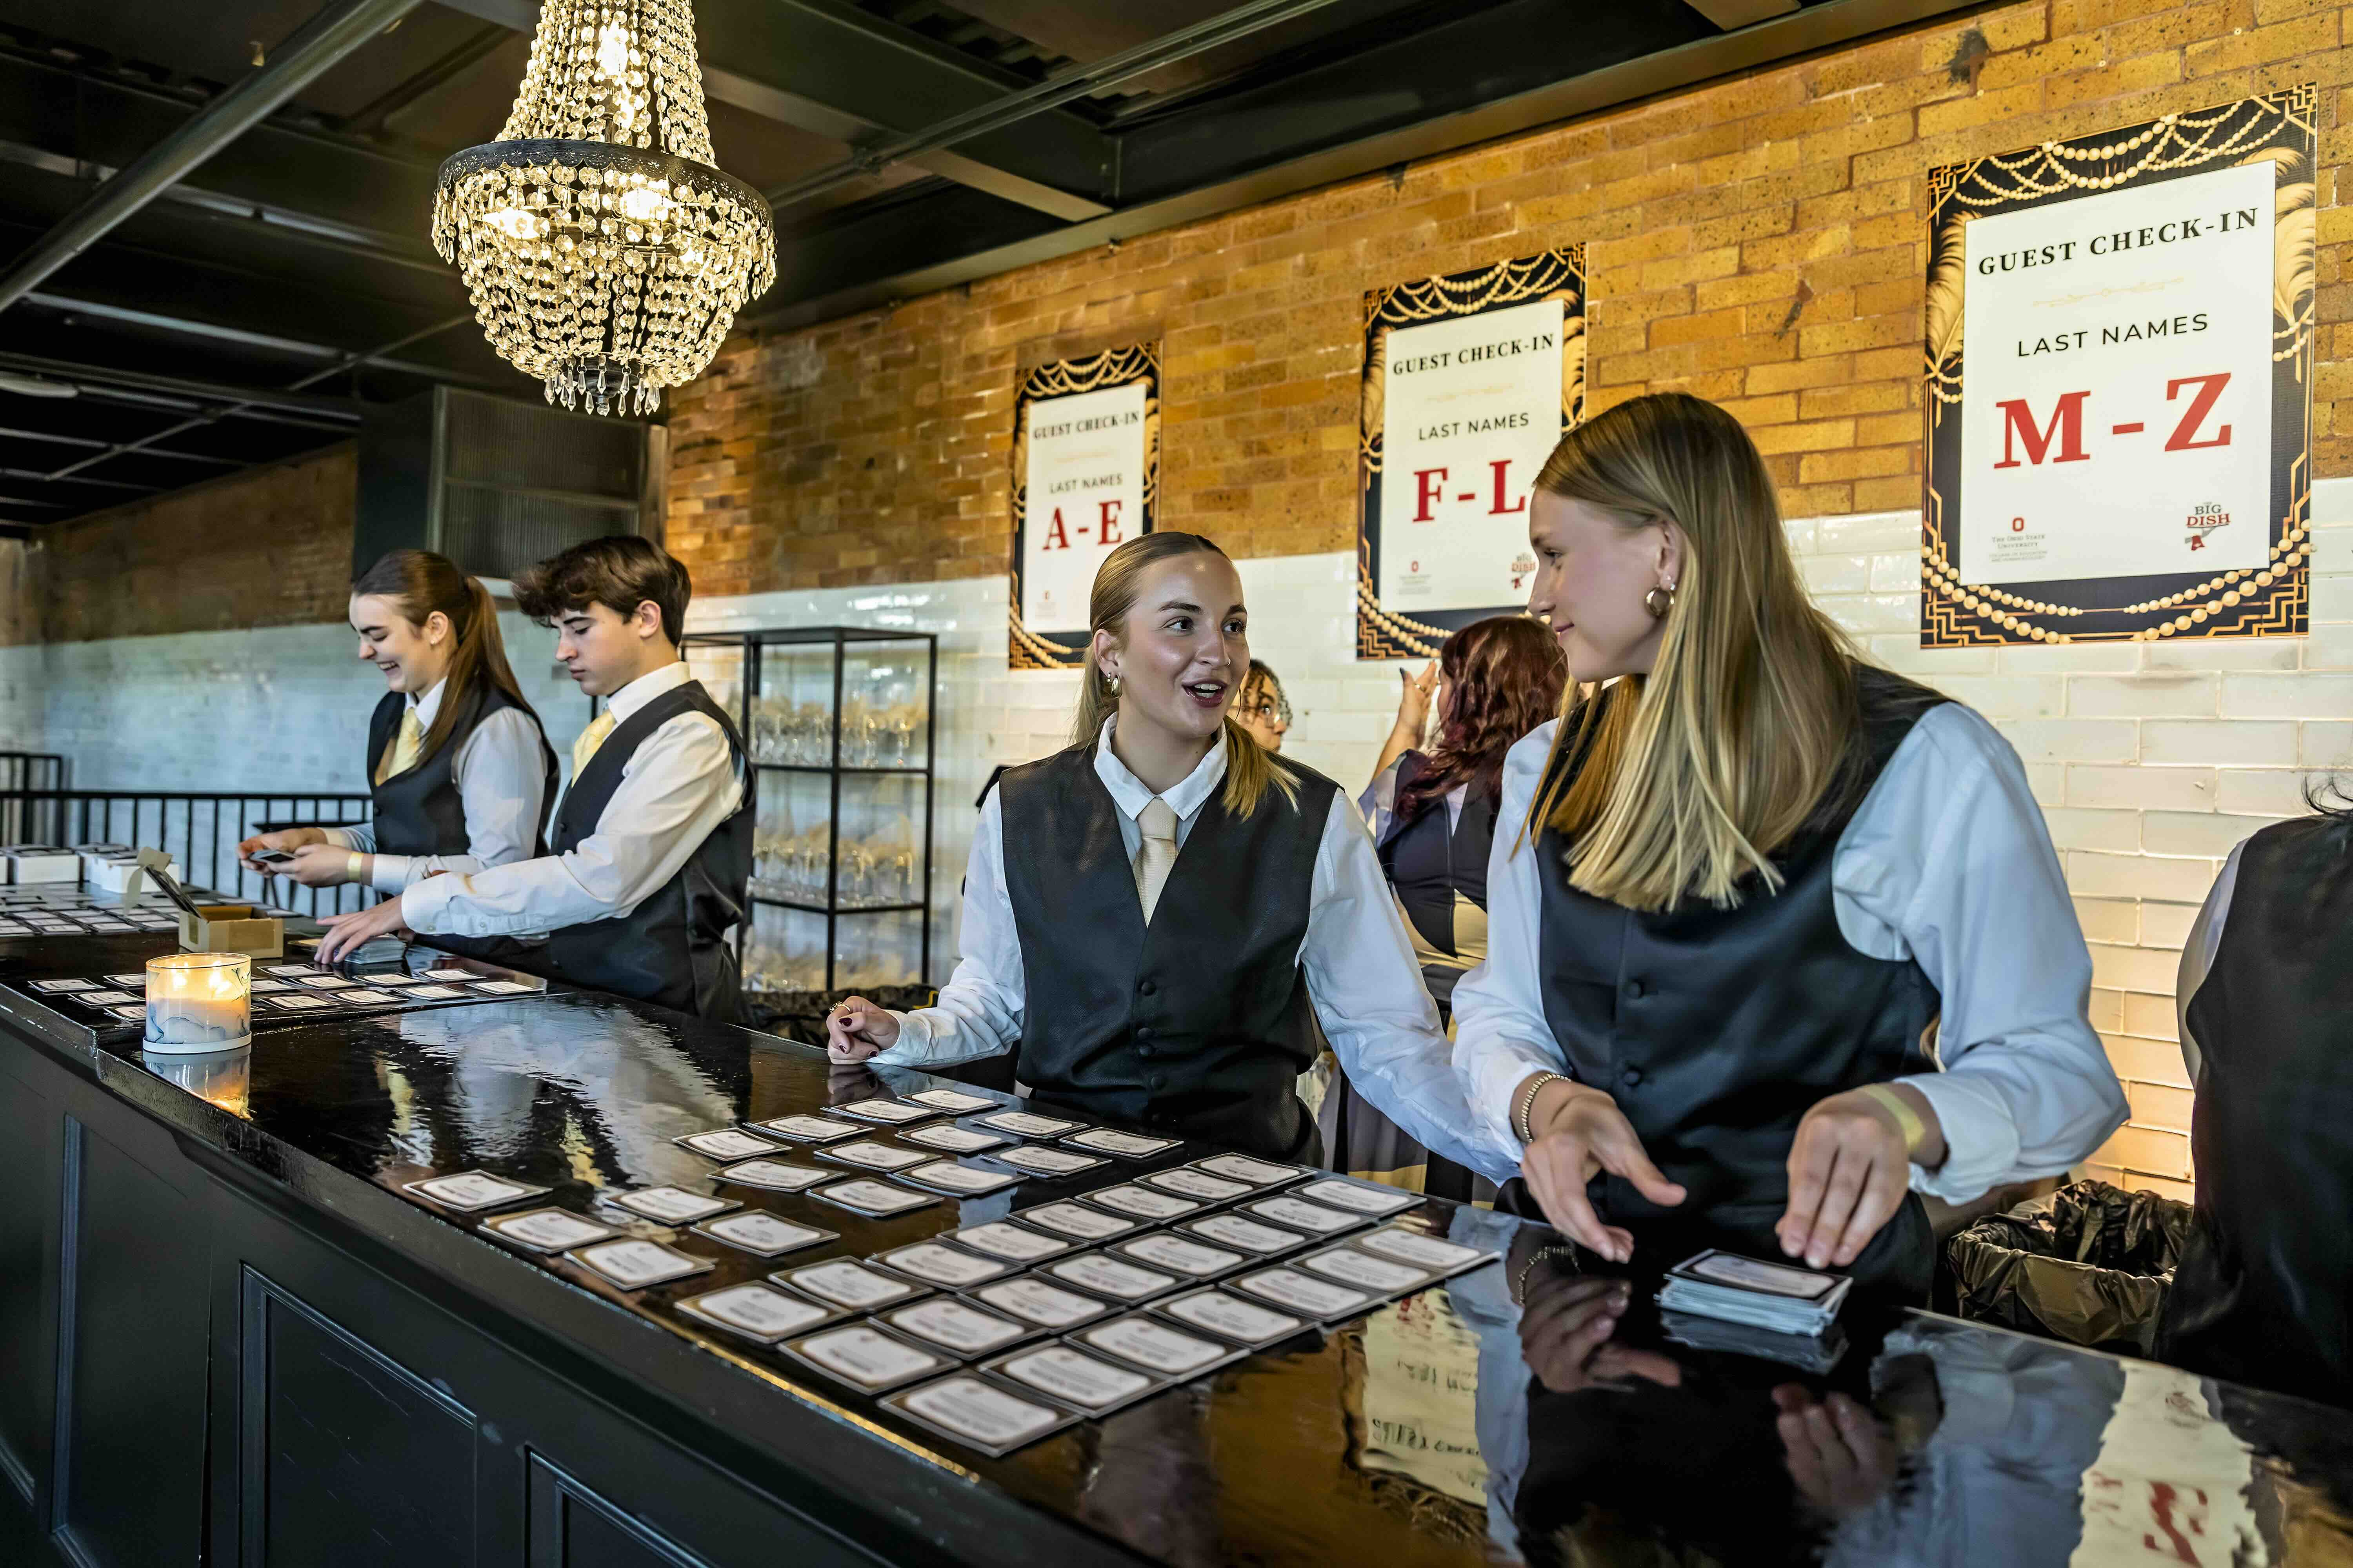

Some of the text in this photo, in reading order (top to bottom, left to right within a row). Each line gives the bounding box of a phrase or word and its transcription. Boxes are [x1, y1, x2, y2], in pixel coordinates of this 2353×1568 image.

[1978, 208, 2258, 275] GUEST CHECK-IN
[2018, 313, 2208, 357] LAST NAMES
[1393, 333, 1554, 375] GUEST CHECK-IN
[1034, 411, 1139, 440] GUEST CHECK-IN
[1419, 412, 1529, 441] LAST NAMES
[1050, 473, 1122, 494] LAST NAMES
[2186, 514, 2231, 527] DISH
[2195, 504, 2222, 515] BIG
